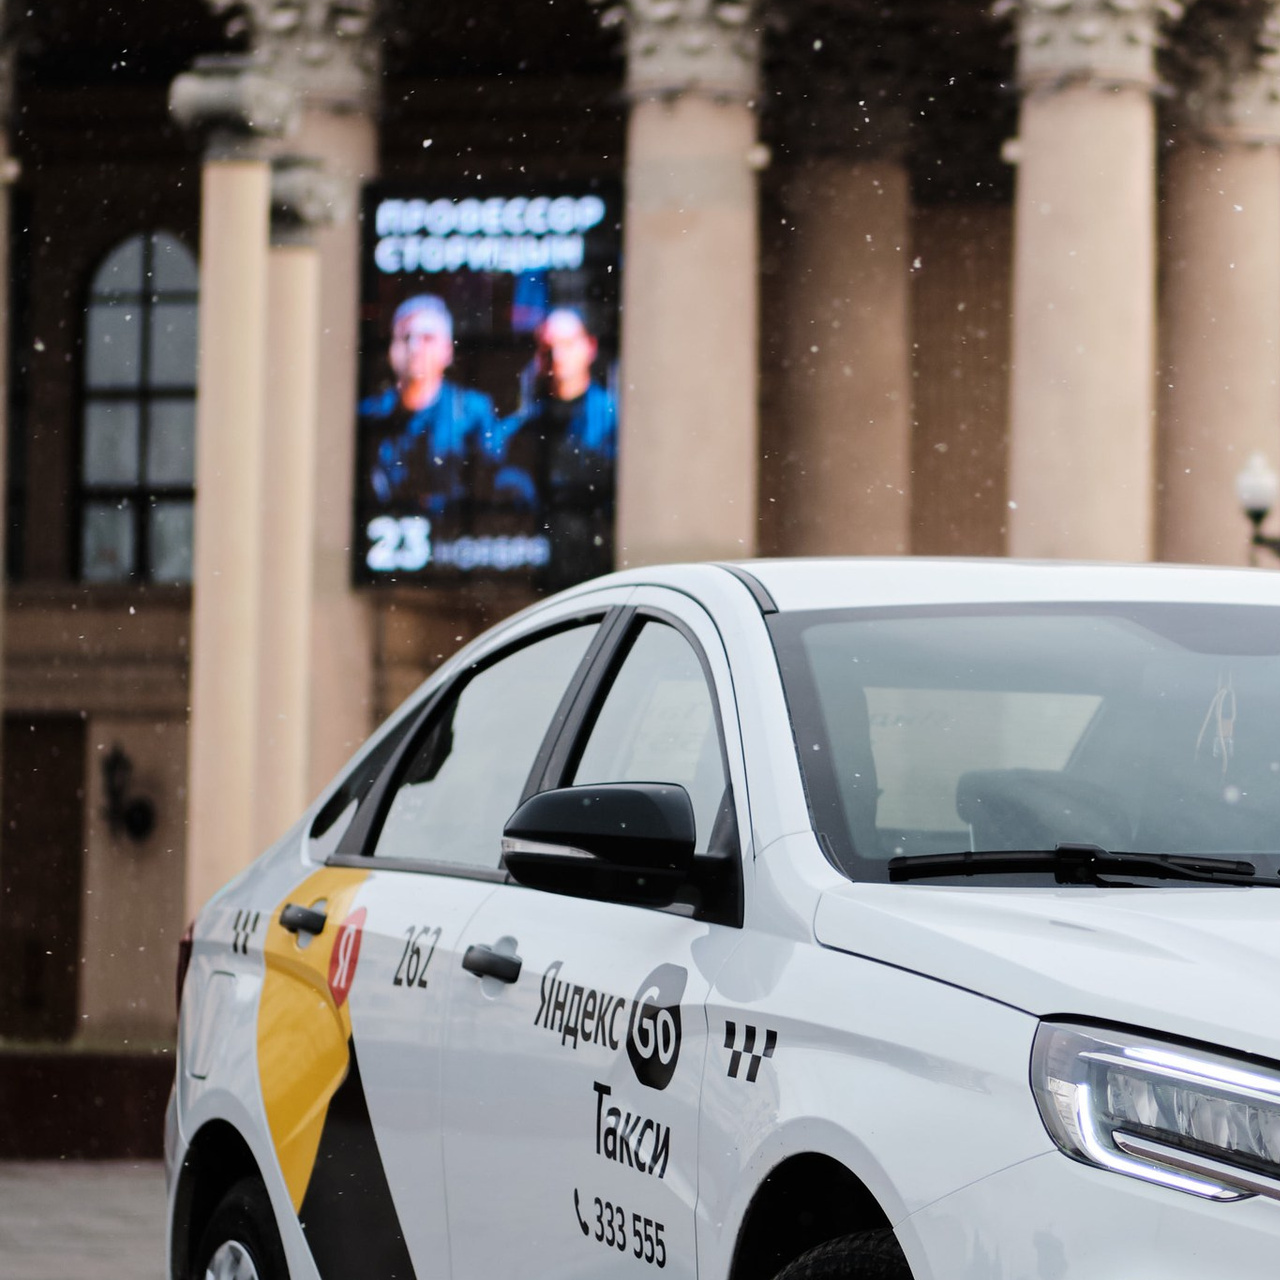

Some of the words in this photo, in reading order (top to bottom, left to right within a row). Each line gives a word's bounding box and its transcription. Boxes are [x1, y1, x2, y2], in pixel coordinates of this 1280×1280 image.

[366, 516, 431, 571] 23
[393, 925, 442, 989] 262
[534, 960, 626, 1050] Яндекс
[632, 986, 676, 1065] Go
[593, 1081, 671, 1179] Такси
[594, 1196, 627, 1252] 333
[632, 1212, 666, 1269] 555
